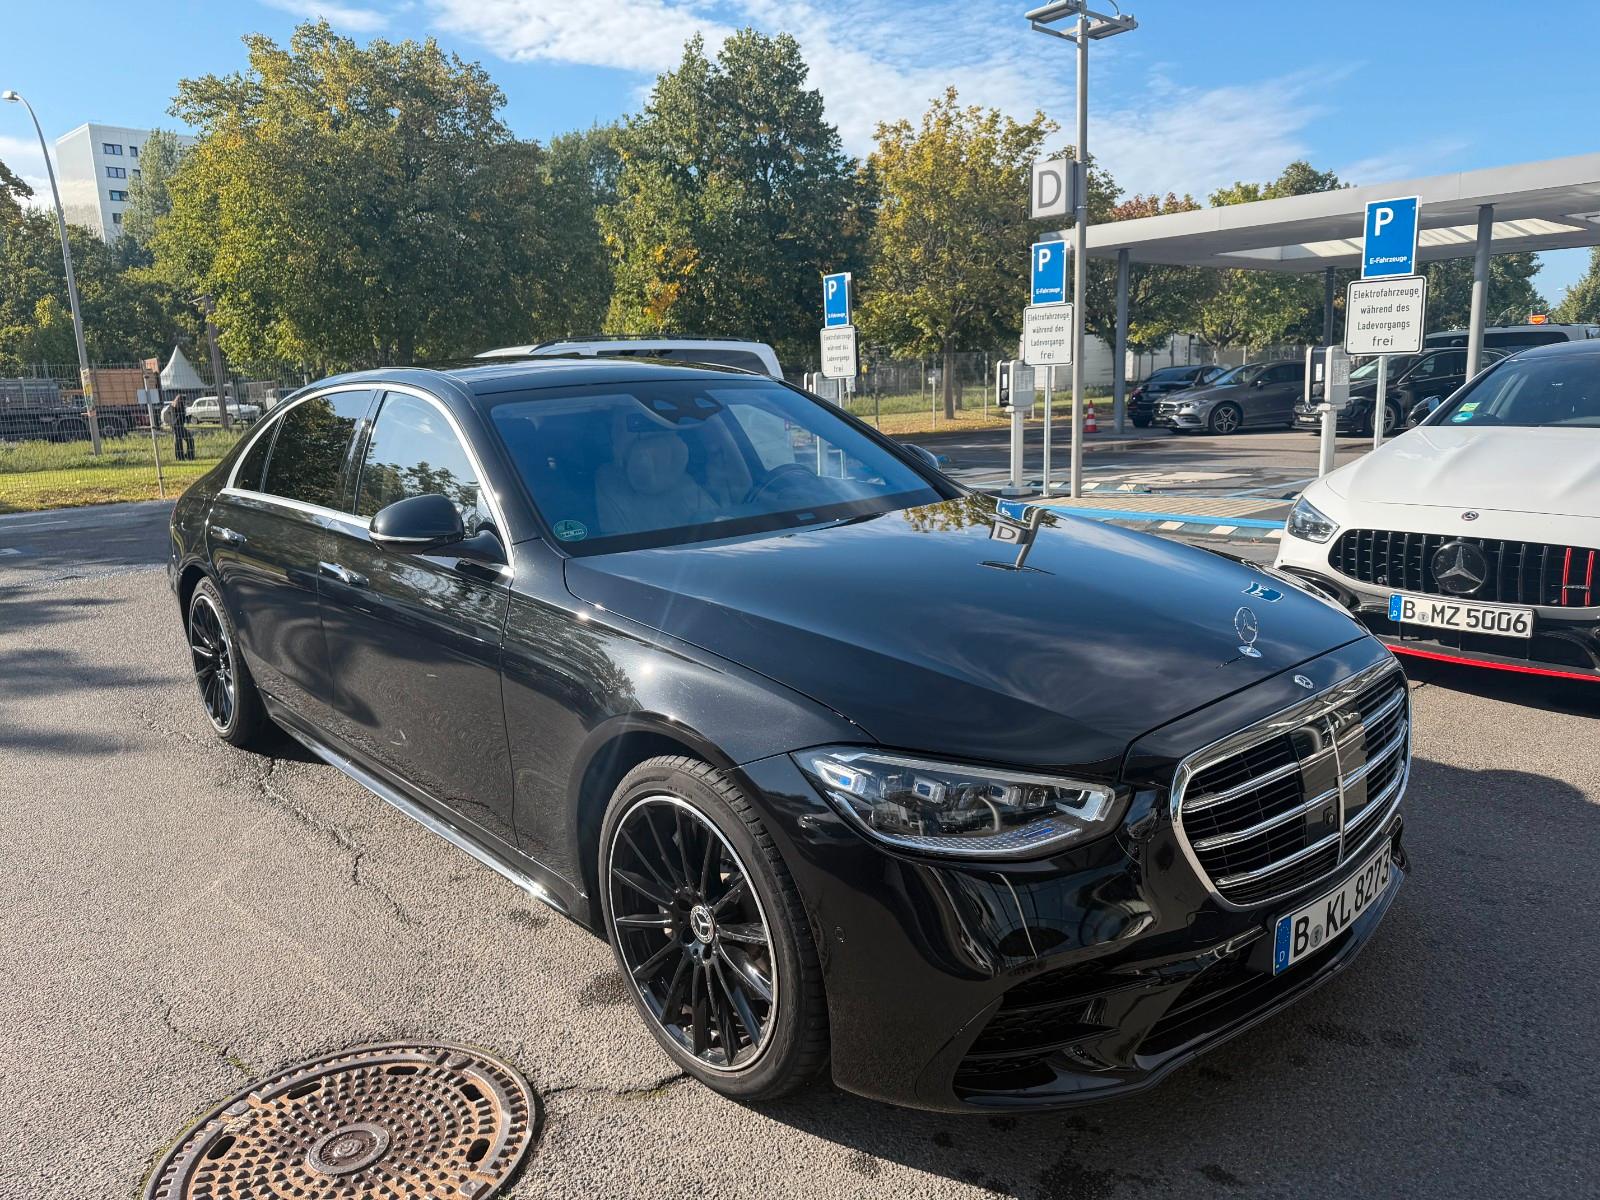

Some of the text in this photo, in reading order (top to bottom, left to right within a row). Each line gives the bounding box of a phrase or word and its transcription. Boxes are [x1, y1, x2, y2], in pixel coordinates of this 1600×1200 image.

[1037, 169, 1062, 210] D
[1374, 207, 1394, 237] P
[1038, 248, 1051, 272] P
[1369, 255, 1408, 265] E-Fahrzeuge
[828, 280, 837, 300] P
[1353, 287, 1419, 300] Elektrofahrzeuge
[1360, 302, 1410, 315] während des
[1027, 312, 1070, 323] Elektrofahrzeuge
[1054, 323, 1064, 333] des
[1357, 320, 1411, 332] Ladevorgangs
[1030, 337, 1065, 348] Ladevorgangs
[1372, 335, 1394, 347] frei
[1040, 349, 1055, 360] frei
[1402, 600, 1416, 619] B
[1430, 603, 1461, 627] MZ
[1466, 608, 1529, 634] 5006
[1293, 915, 1310, 958] B
[1325, 890, 1351, 938] KL
[1354, 850, 1390, 913] 8273
